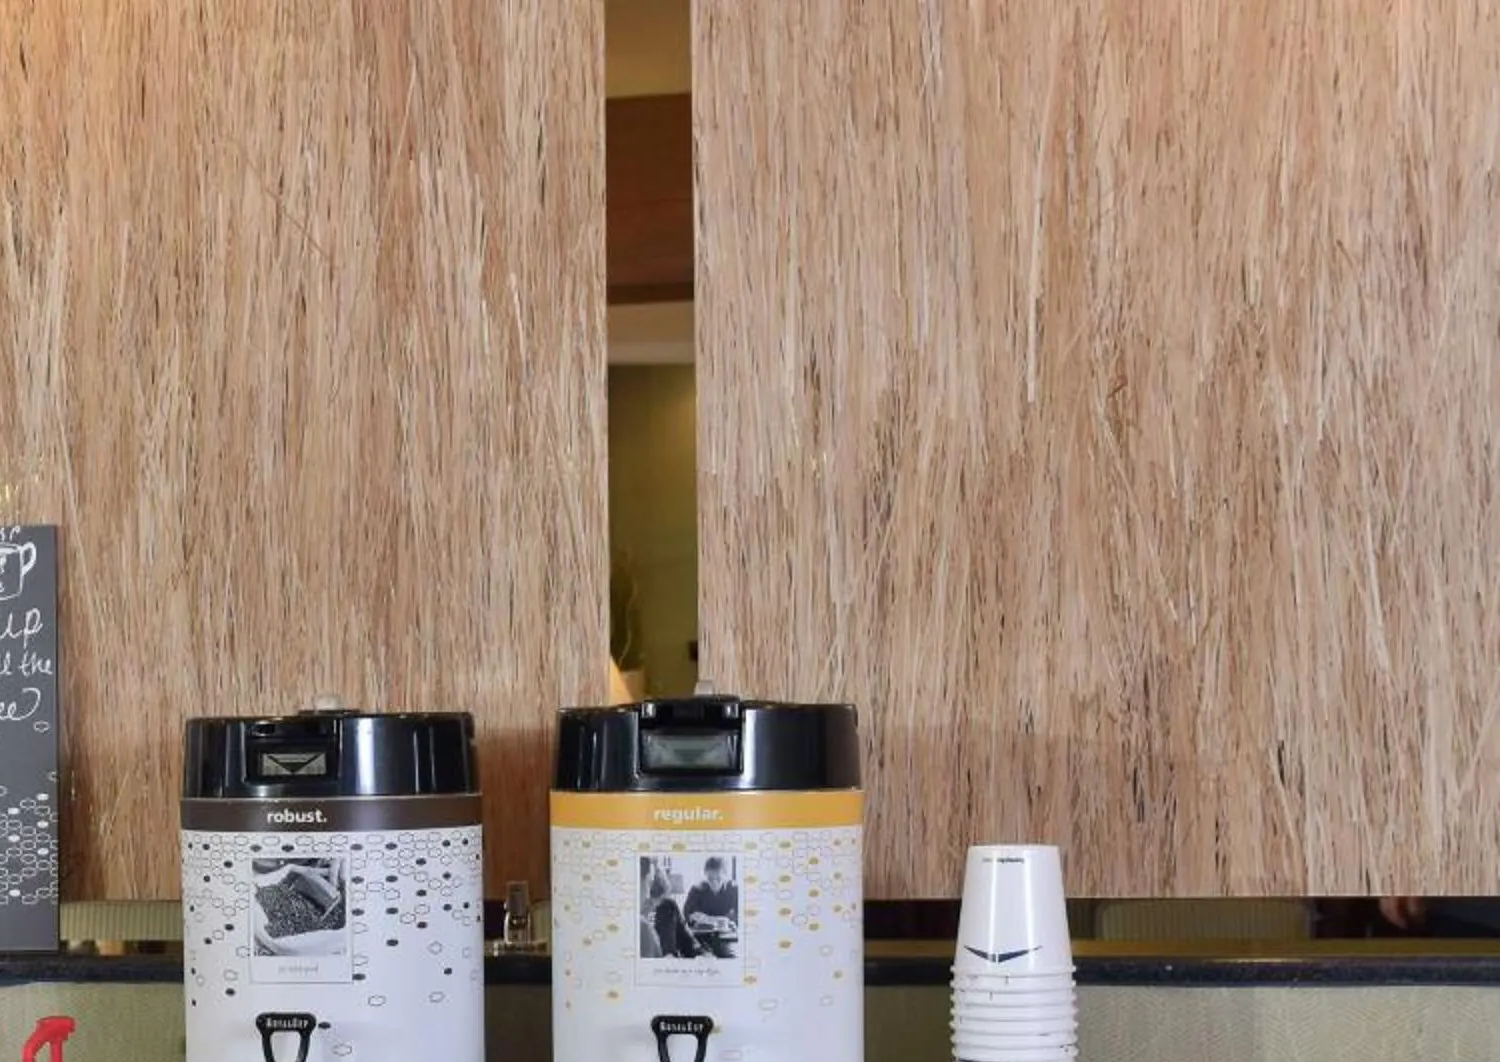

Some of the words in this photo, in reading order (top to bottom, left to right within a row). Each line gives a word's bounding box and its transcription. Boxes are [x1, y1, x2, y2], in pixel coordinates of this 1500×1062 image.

[18, 651, 53, 676] the
[266, 807, 328, 823] robust.
[652, 806, 724, 824] regular.
